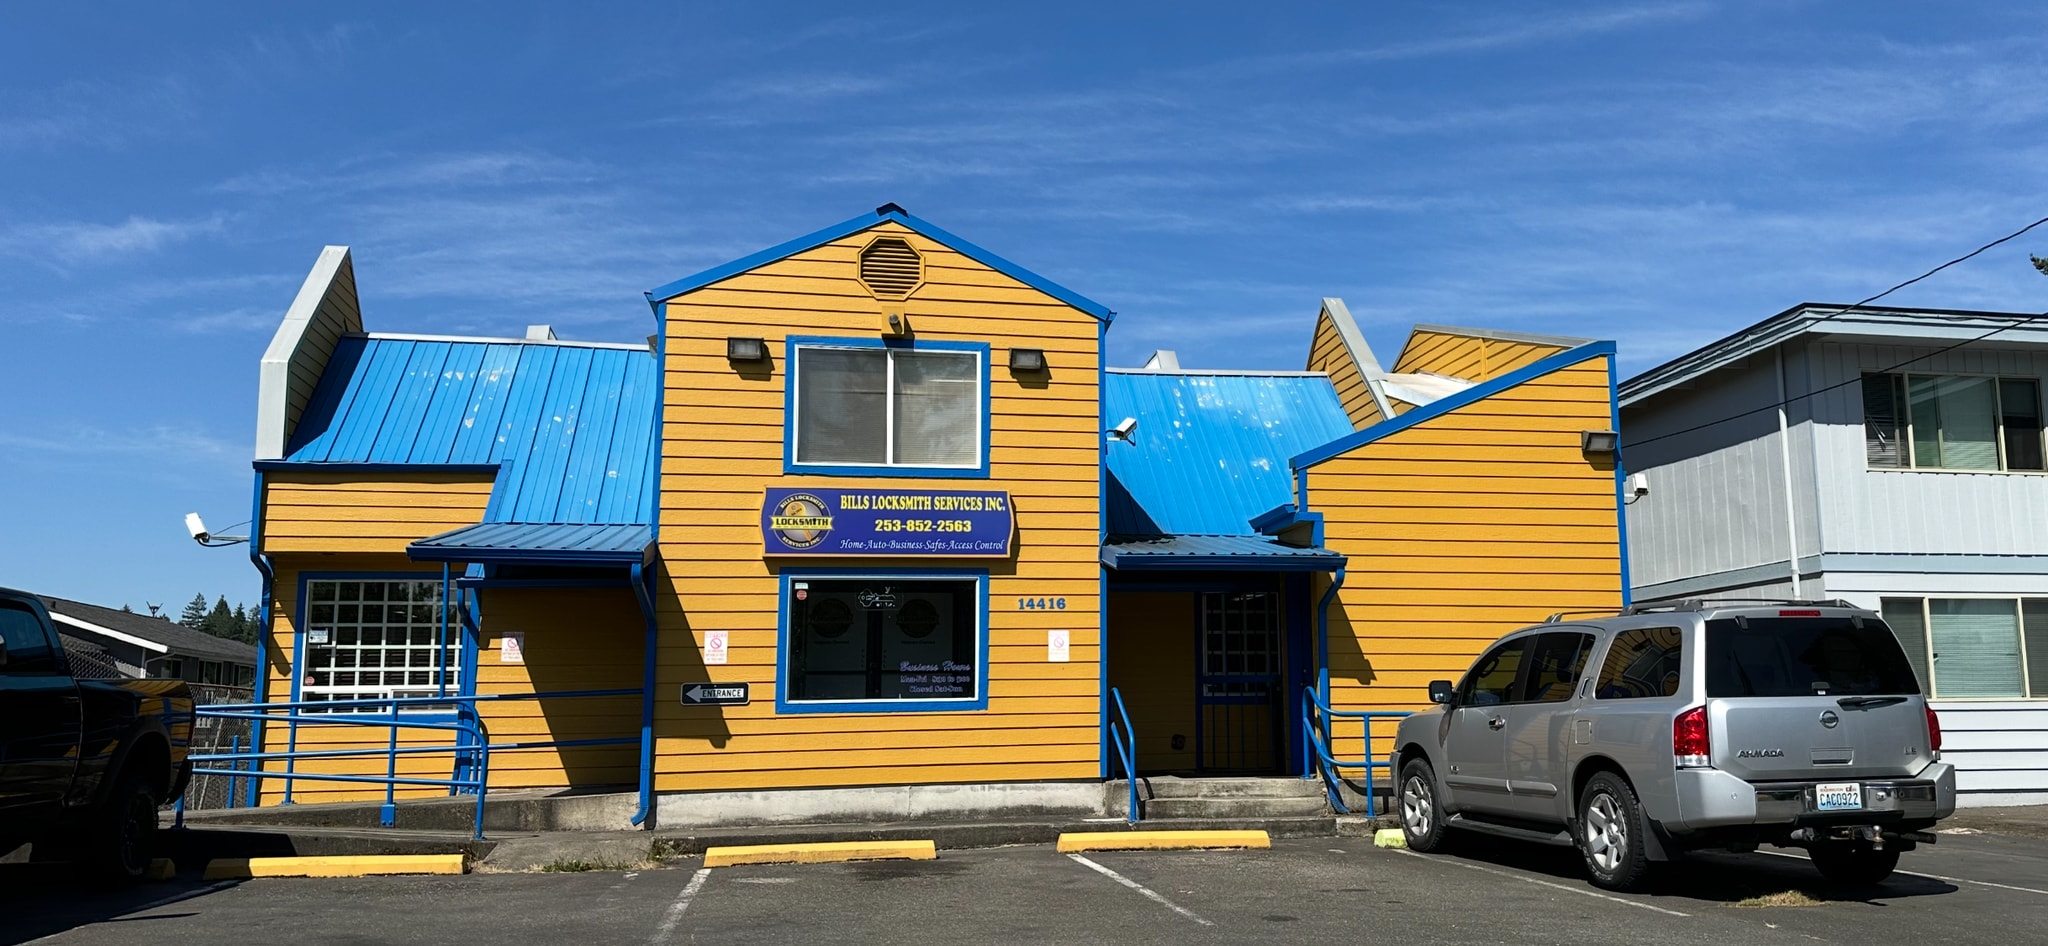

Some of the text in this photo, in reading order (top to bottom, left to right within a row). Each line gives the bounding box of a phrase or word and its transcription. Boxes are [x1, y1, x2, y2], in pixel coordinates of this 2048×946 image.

[840, 495, 1006, 511] BILLS LOCKSMITH SERVICES INC.
[776, 517, 829, 526] LOCKSMITH
[874, 519, 972, 532] 253-852-2563
[974, 539, 1006, 551] Control
[1018, 597, 1066, 610] 14416
[900, 660, 971, 671] Business Hours
[702, 689, 742, 698] ENTRANCE
[1736, 746, 1918, 759] ARMADA LE
[1820, 792, 1859, 806] CAC0922
